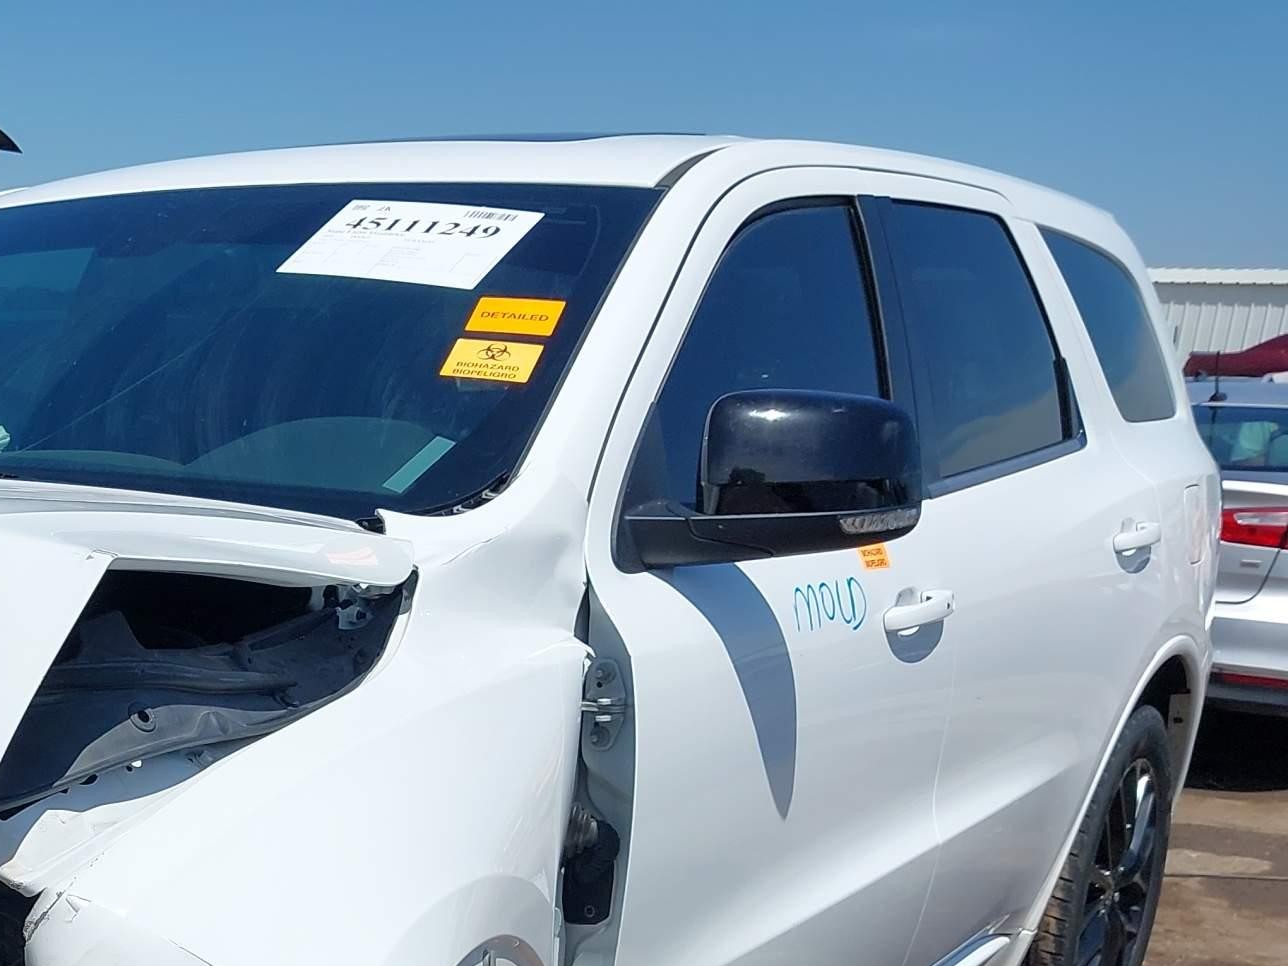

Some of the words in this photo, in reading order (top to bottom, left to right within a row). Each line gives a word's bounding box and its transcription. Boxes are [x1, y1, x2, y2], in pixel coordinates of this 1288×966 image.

[345, 215, 502, 239] 45111249
[480, 311, 550, 322] DETAILED
[455, 361, 520, 372] BIOHAZARD
[452, 368, 517, 379] BIOPELIGRO
